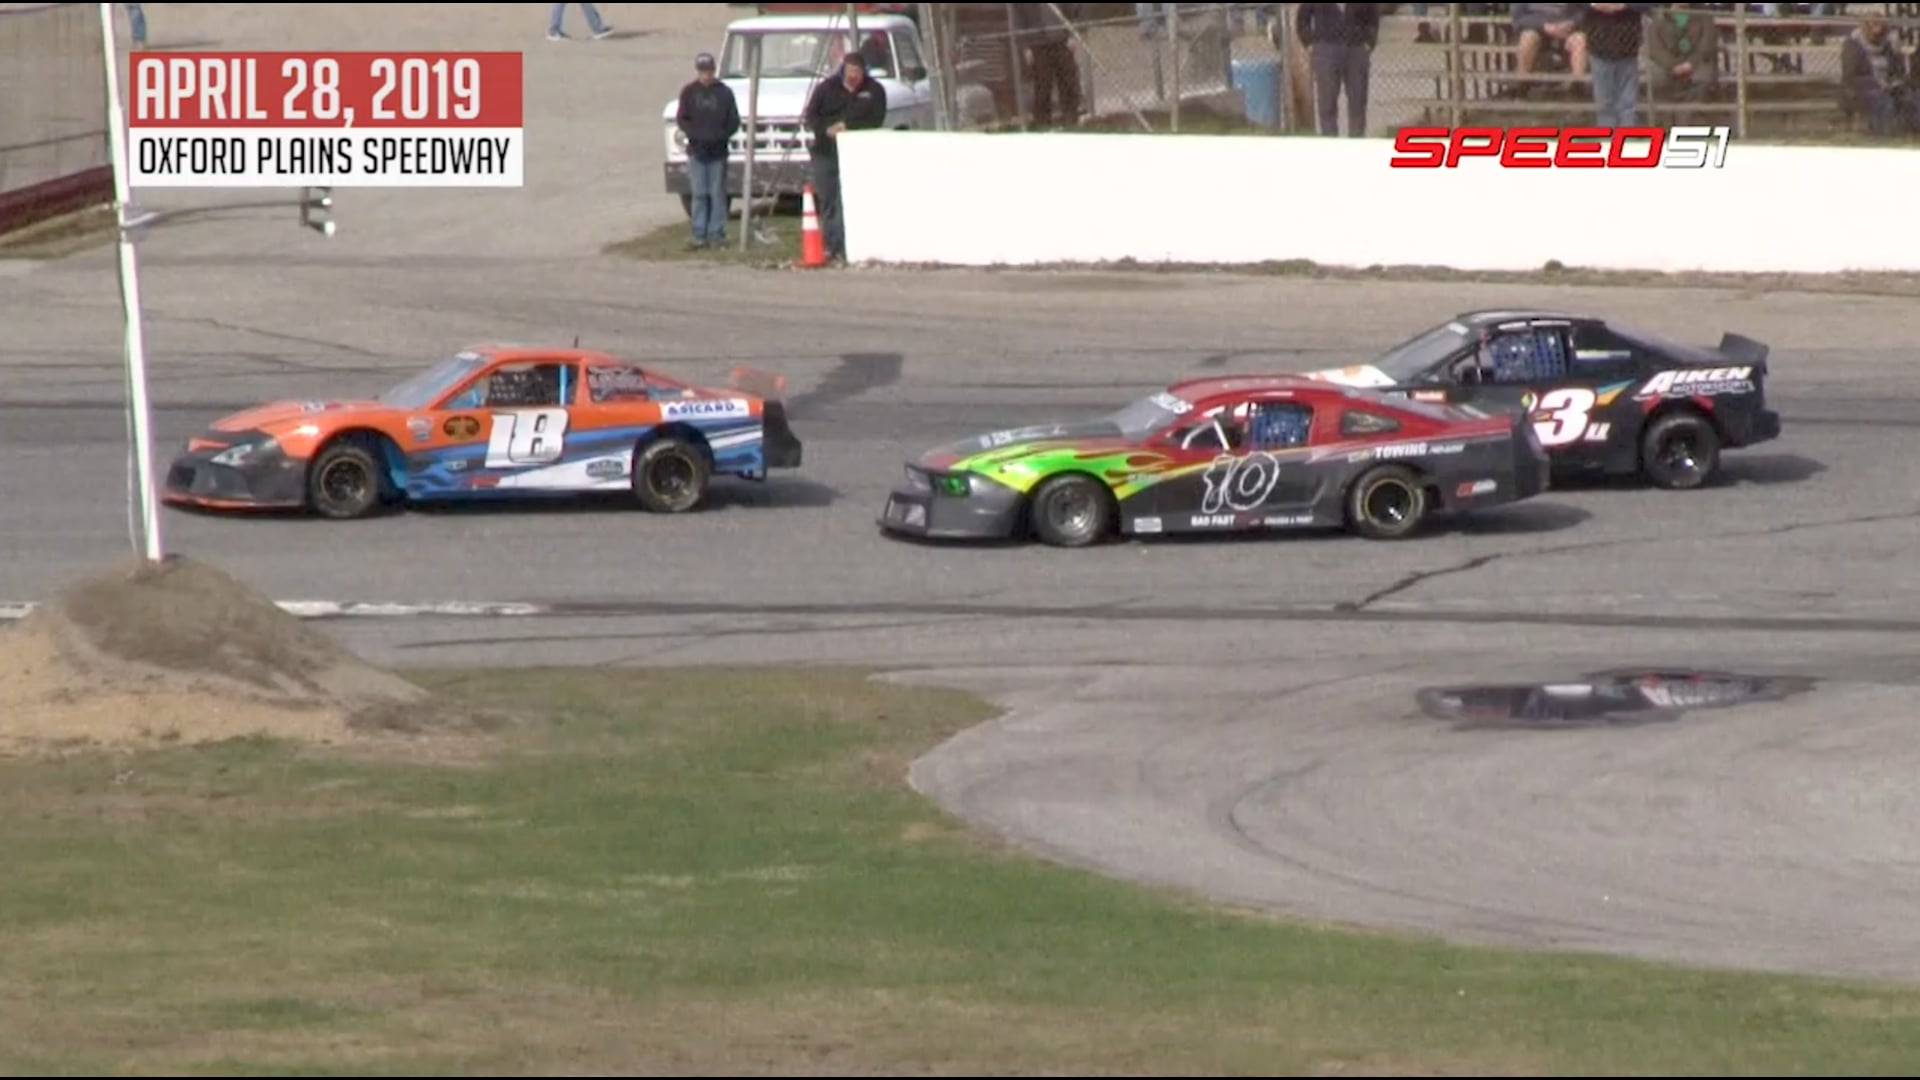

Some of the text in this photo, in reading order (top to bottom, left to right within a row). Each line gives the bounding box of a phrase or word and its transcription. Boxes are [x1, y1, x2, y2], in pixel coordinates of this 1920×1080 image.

[1640, 366, 1753, 395] AIKEN
[484, 408, 569, 468] 18
[1374, 442, 1428, 459] TOWING
[1202, 451, 1280, 514] 10
